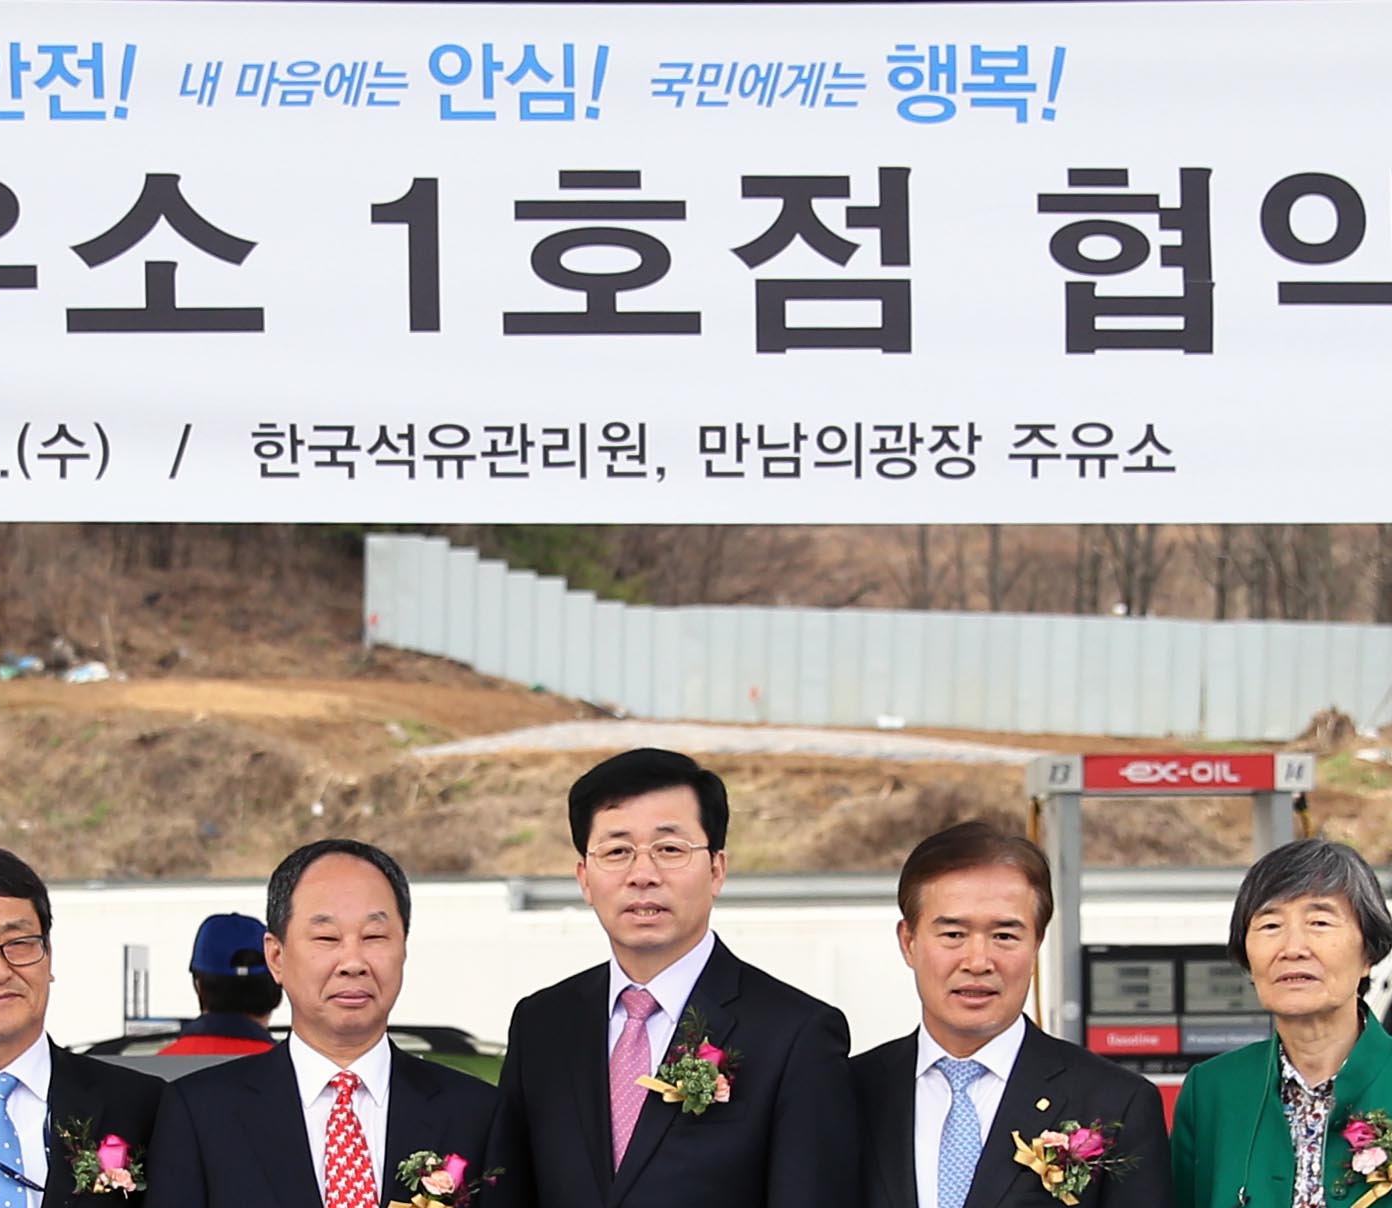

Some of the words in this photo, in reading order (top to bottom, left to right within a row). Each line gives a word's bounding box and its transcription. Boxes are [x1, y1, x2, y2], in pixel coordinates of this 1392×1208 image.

[180, 61, 223, 106] 내
[236, 61, 408, 107] 마음에는
[429, 43, 609, 121] 안심!
[651, 62, 866, 107] 국민에게는
[887, 44, 1066, 124] 행복!
[371, 167, 912, 354] 1호점
[170, 424, 192, 478] /
[252, 422, 665, 482] 한국석유관리원,
[700, 422, 982, 479] 만남의광장
[1009, 422, 1176, 478] 주유소
